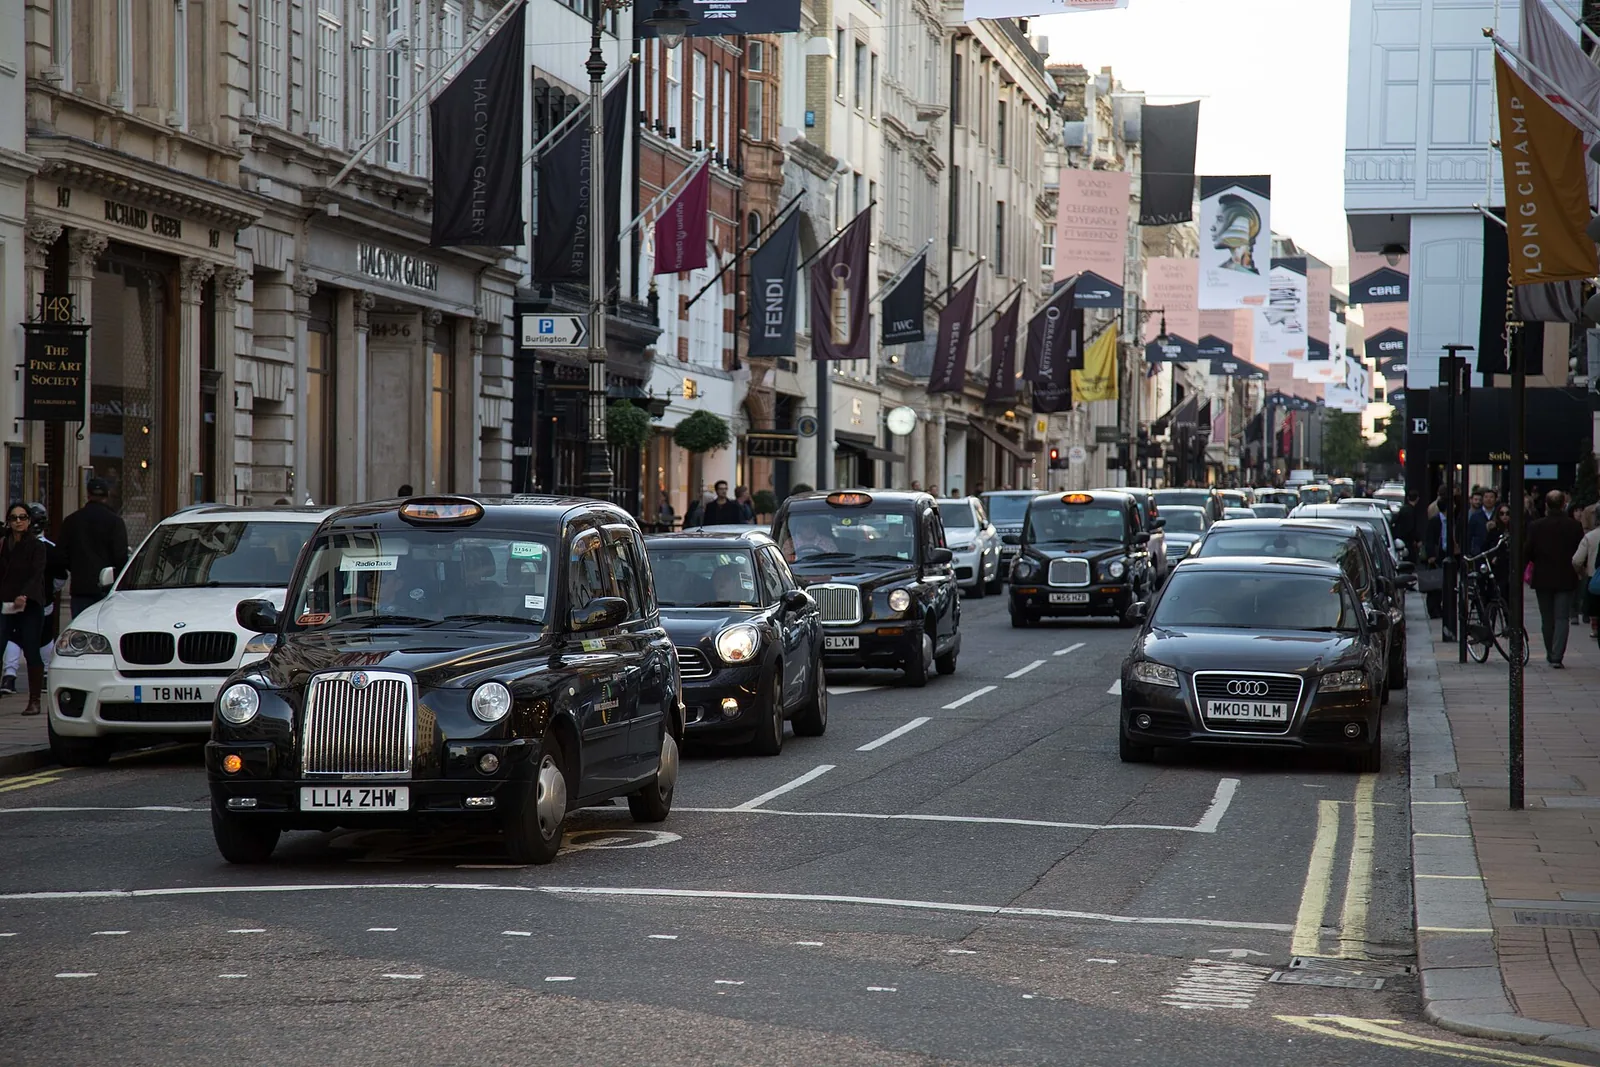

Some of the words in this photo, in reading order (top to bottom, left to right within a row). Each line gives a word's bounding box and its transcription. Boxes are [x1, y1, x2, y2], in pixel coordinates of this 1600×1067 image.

[474, 78, 488, 158] HALCYON
[1511, 97, 1542, 274] LONGCHAMP
[471, 166, 487, 236] GALLERY
[104, 200, 148, 230] RICHARD
[151, 213, 182, 239] GREEN
[572, 215, 588, 276] GALLERY
[357, 243, 402, 282] HALCYON
[401, 255, 440, 291] GALLERY
[1368, 285, 1400, 296] CBRE
[44, 296, 70, 321] 148
[764, 278, 783, 338] FENDI
[542, 320, 552, 332] P
[893, 319, 914, 332] IWC
[525, 335, 567, 344] Burlington
[1379, 341, 1404, 351] CBRE
[30, 360, 56, 371] FINE
[58, 361, 82, 371] ART
[31, 375, 79, 386] SOCIETY
[751, 439, 795, 455] ZILLI
[415, 504, 464, 516] TAXI
[835, 636, 855, 647] LXW
[153, 687, 171, 700] T8
[174, 687, 203, 701] NHA
[1213, 704, 1250, 717] MK09
[1254, 704, 1282, 718] NLM
[312, 788, 353, 808] LL14
[359, 788, 397, 808] ZHW
